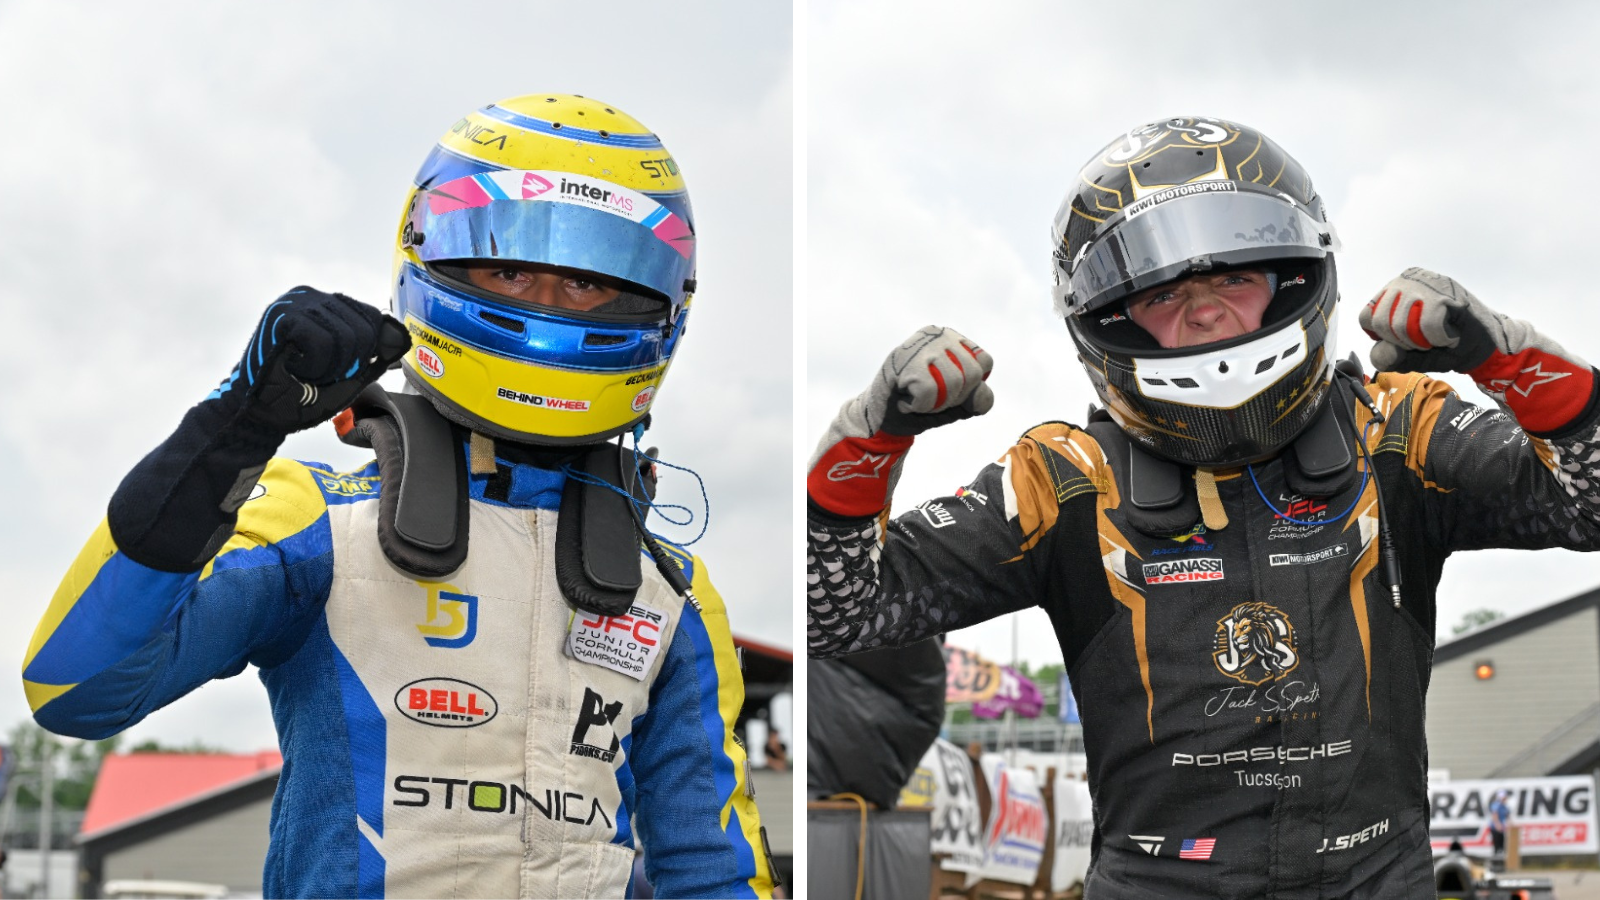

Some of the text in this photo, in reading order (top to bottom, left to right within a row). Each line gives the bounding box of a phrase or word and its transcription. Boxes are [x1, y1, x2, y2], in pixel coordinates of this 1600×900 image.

[560, 178, 633, 211] interMS
[1129, 182, 1232, 216] KIWI MOTORSPORT
[418, 348, 440, 373] BELL
[497, 387, 588, 410] BEHIND WHEEL
[1272, 510, 1326, 526] JUOR
[1146, 571, 1223, 583] RACING
[1160, 559, 1222, 575] GANASSI
[627, 605, 662, 624] ER
[578, 628, 650, 655] JUNIOR
[582, 614, 659, 647] JFC
[574, 646, 643, 672] CHAMPIONSHIP
[575, 637, 645, 665] FORMULA
[1204, 686, 1257, 717] Jack
[417, 711, 474, 722] HELMETS
[393, 775, 613, 829] STONICA
[1316, 818, 1389, 853] J.SPETH
